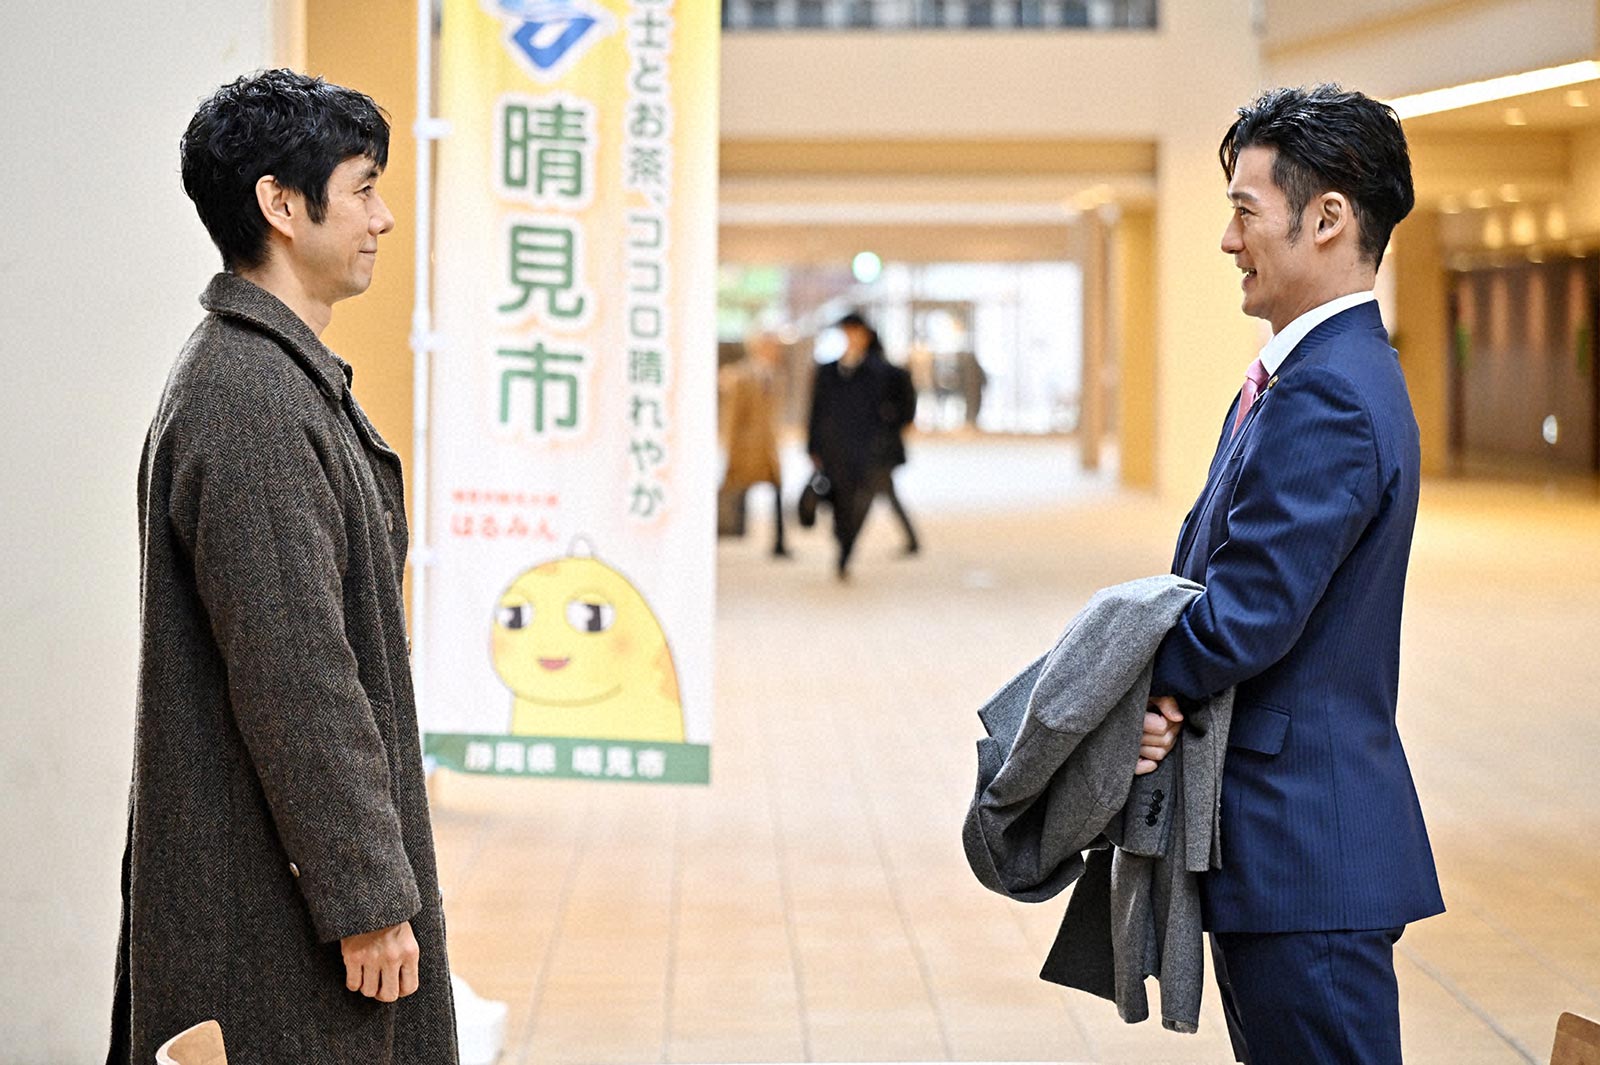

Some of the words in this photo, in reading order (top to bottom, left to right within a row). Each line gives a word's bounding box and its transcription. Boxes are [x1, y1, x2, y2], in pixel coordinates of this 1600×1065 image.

[496, 102, 588, 433] 晴見市
[628, 0, 667, 517] 士とお茶、ココロ晴れやか
